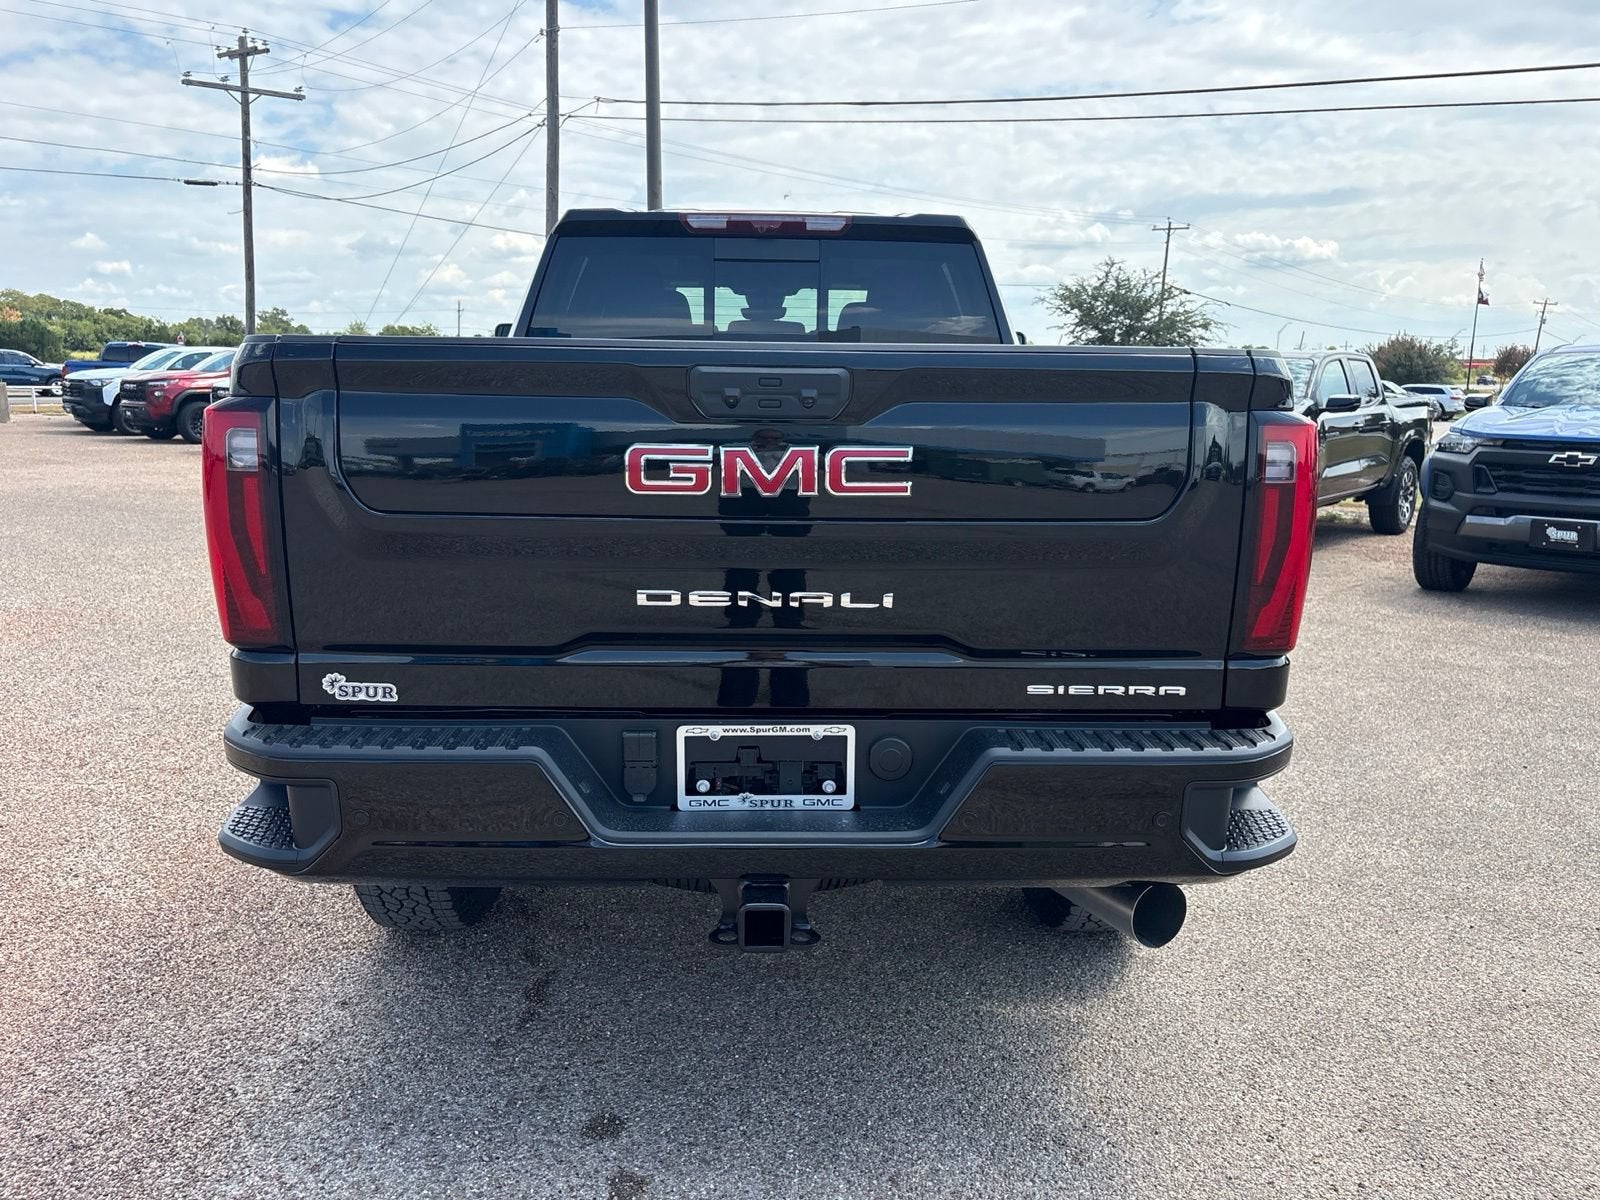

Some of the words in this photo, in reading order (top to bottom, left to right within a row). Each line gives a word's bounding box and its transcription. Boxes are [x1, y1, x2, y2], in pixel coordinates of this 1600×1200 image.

[625, 444, 914, 497] GMC
[636, 589, 894, 609] DENALI
[338, 685, 395, 699] SPUR
[1026, 684, 1187, 696] SIERRA
[721, 726, 811, 735] www.SpurGM.com
[688, 799, 730, 807] GMC
[749, 799, 795, 808] SPUR
[802, 798, 843, 807] GMC
